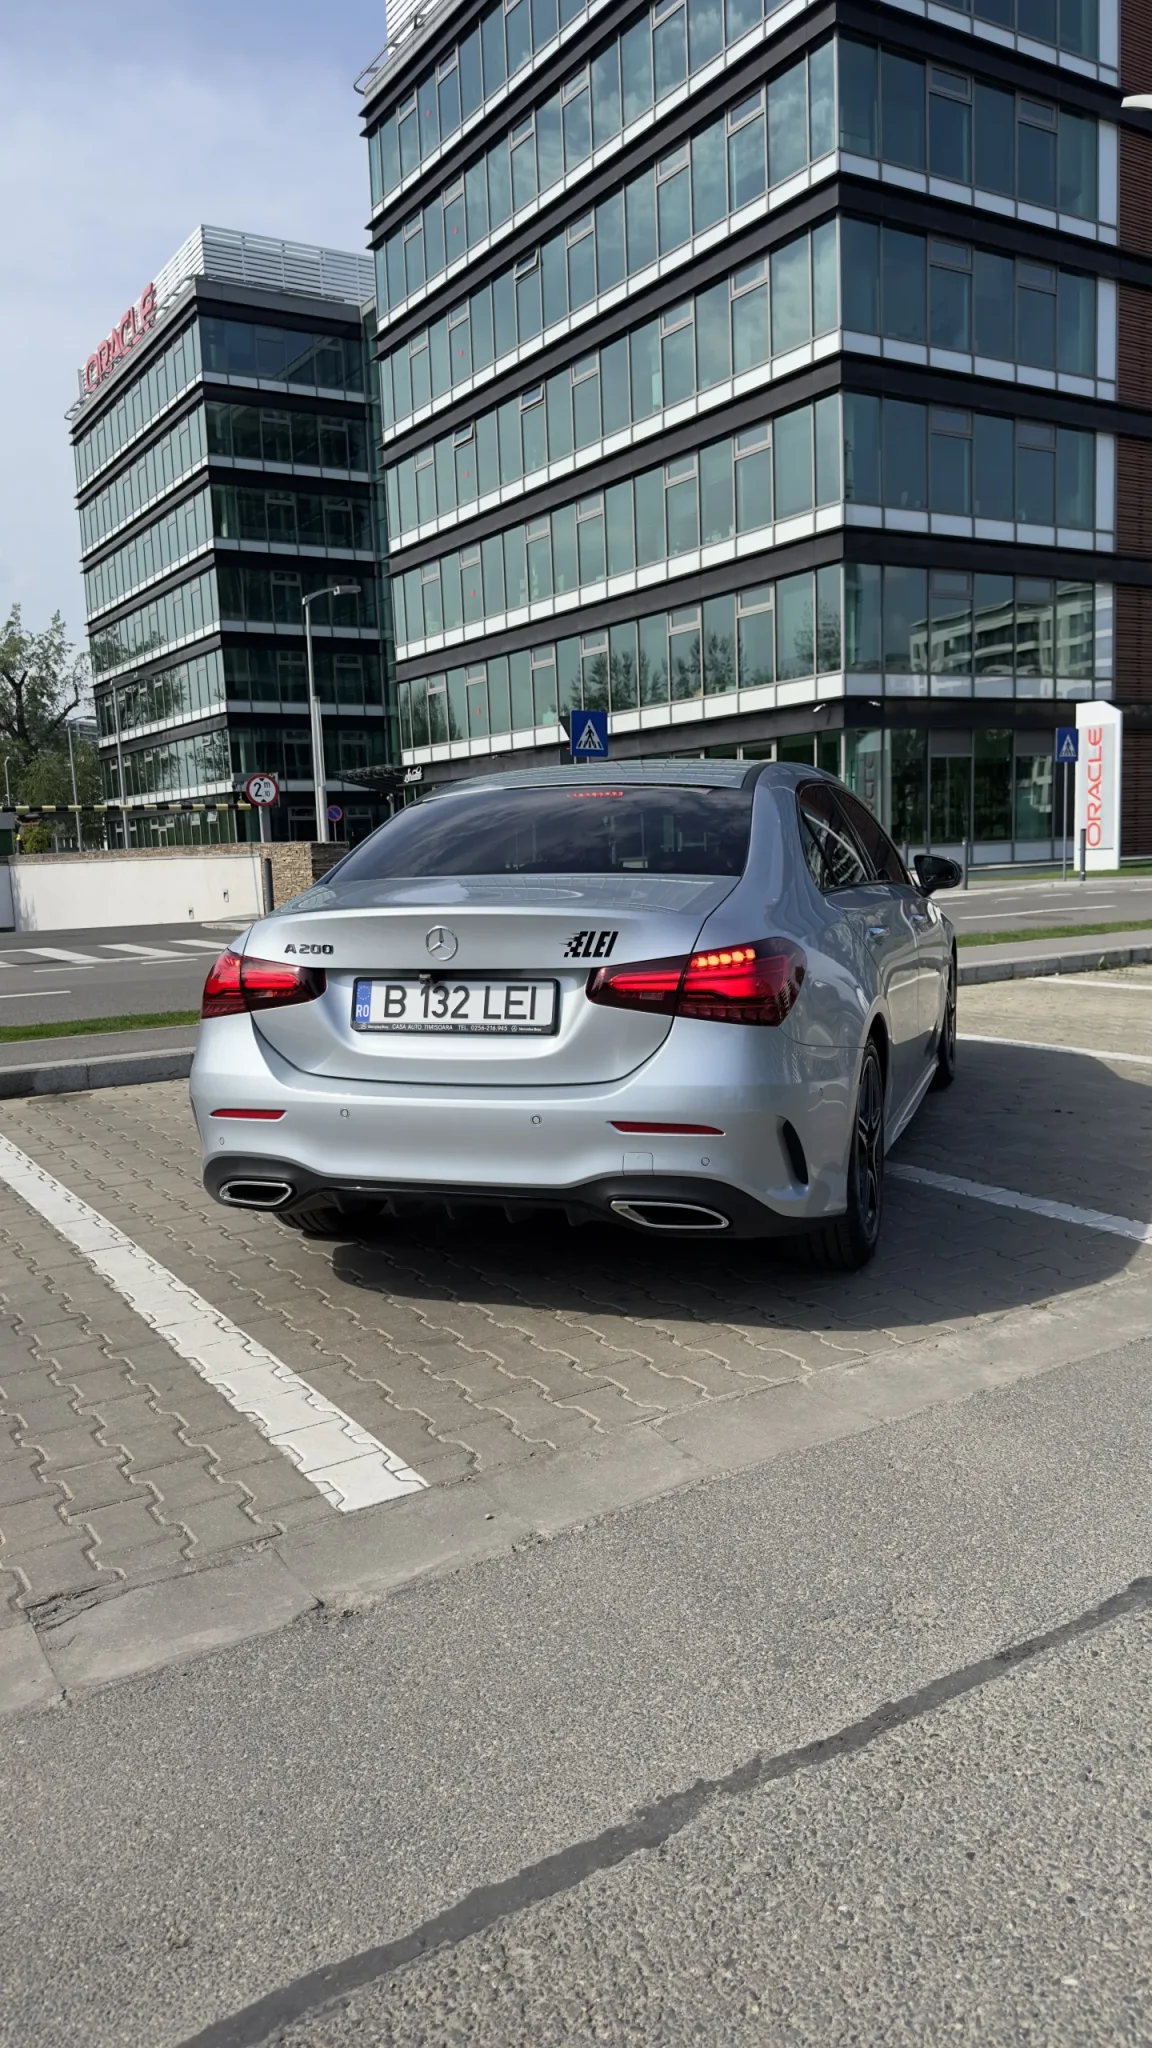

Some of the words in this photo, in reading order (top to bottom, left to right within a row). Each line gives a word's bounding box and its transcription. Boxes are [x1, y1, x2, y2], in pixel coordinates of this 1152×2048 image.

[85, 282, 156, 393] ORACLE
[1086, 727, 1103, 847] ORACLE
[284, 943, 297, 954] A
[299, 943, 334, 955] 200
[355, 1004, 370, 1018] RO
[384, 984, 407, 1018] B
[420, 984, 470, 1018] 132
[483, 985, 537, 1020] LEI
